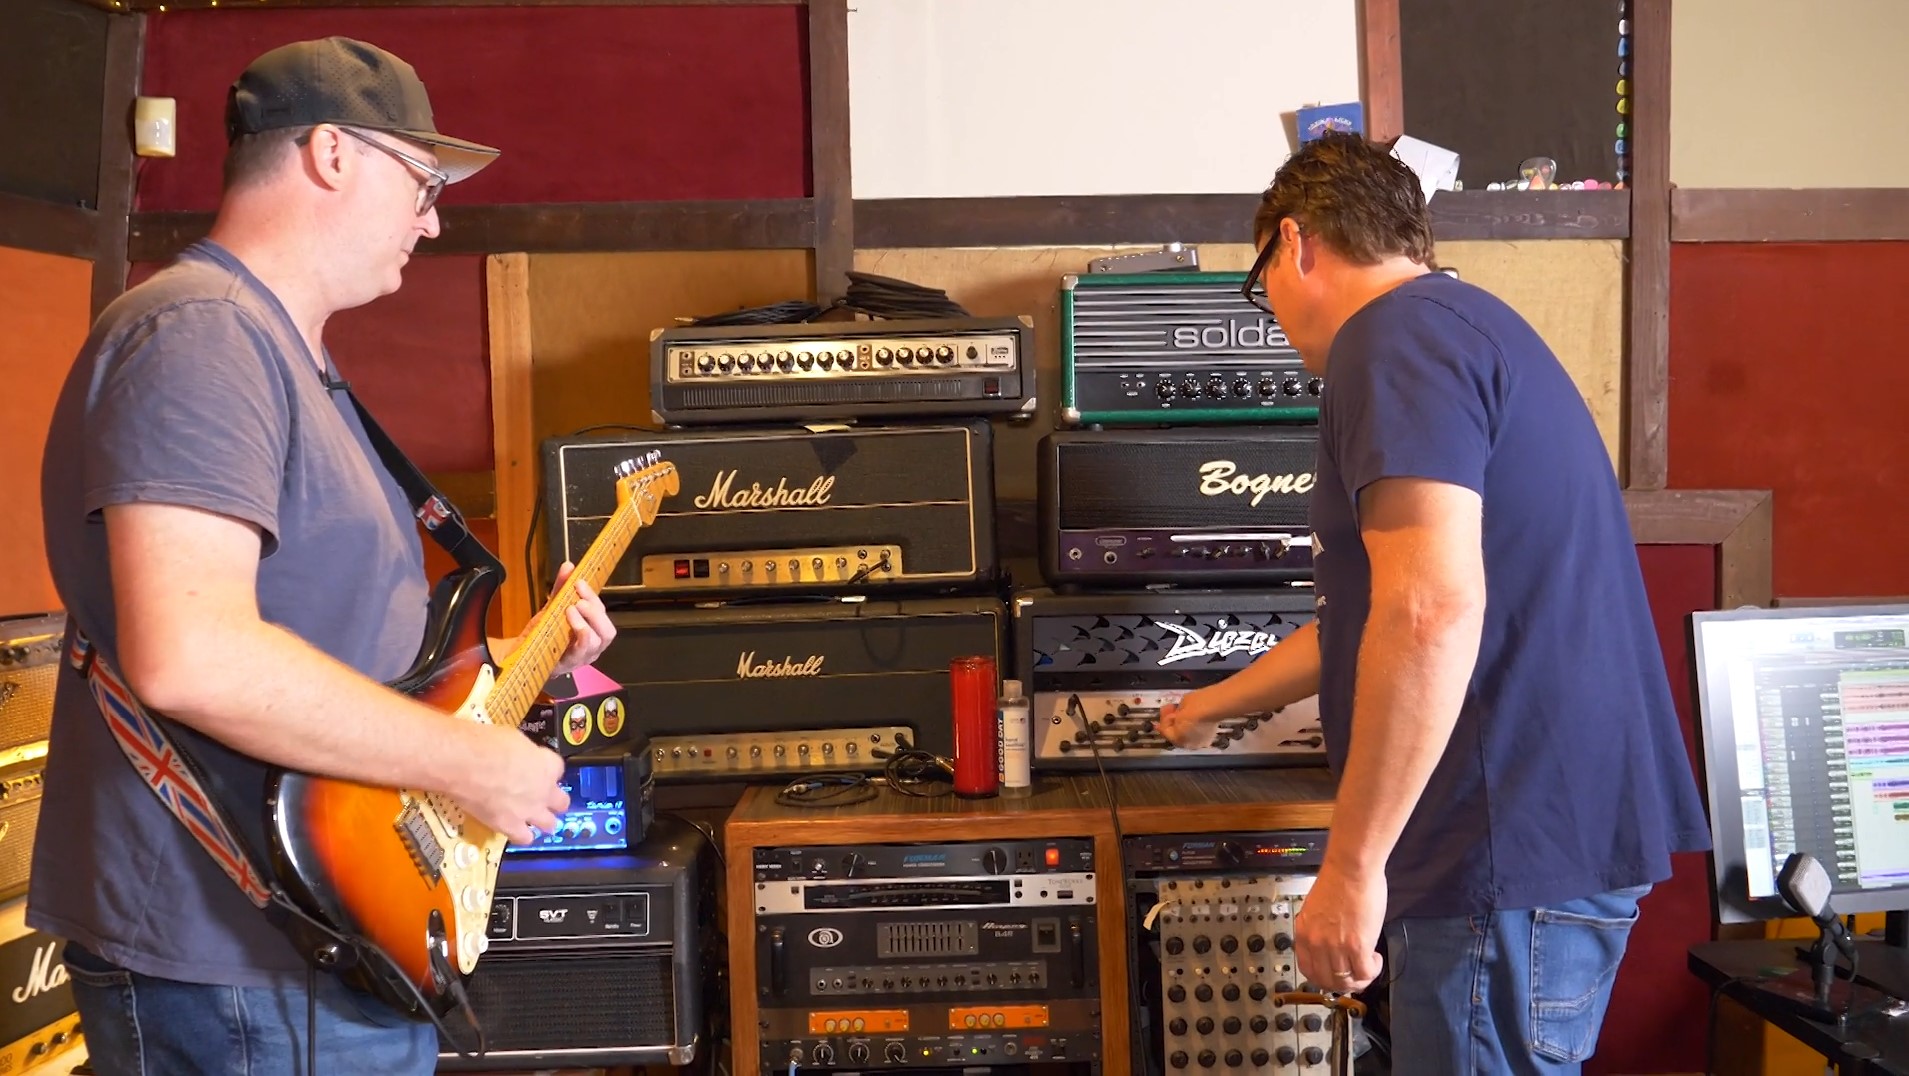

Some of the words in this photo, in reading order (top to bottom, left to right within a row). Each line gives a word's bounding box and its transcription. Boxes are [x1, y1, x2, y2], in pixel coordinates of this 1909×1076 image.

[694, 469, 836, 509] Marshall
[1199, 460, 1317, 507] Bogne
[736, 651, 825, 679] Marshall
[539, 909, 569, 919] SVT
